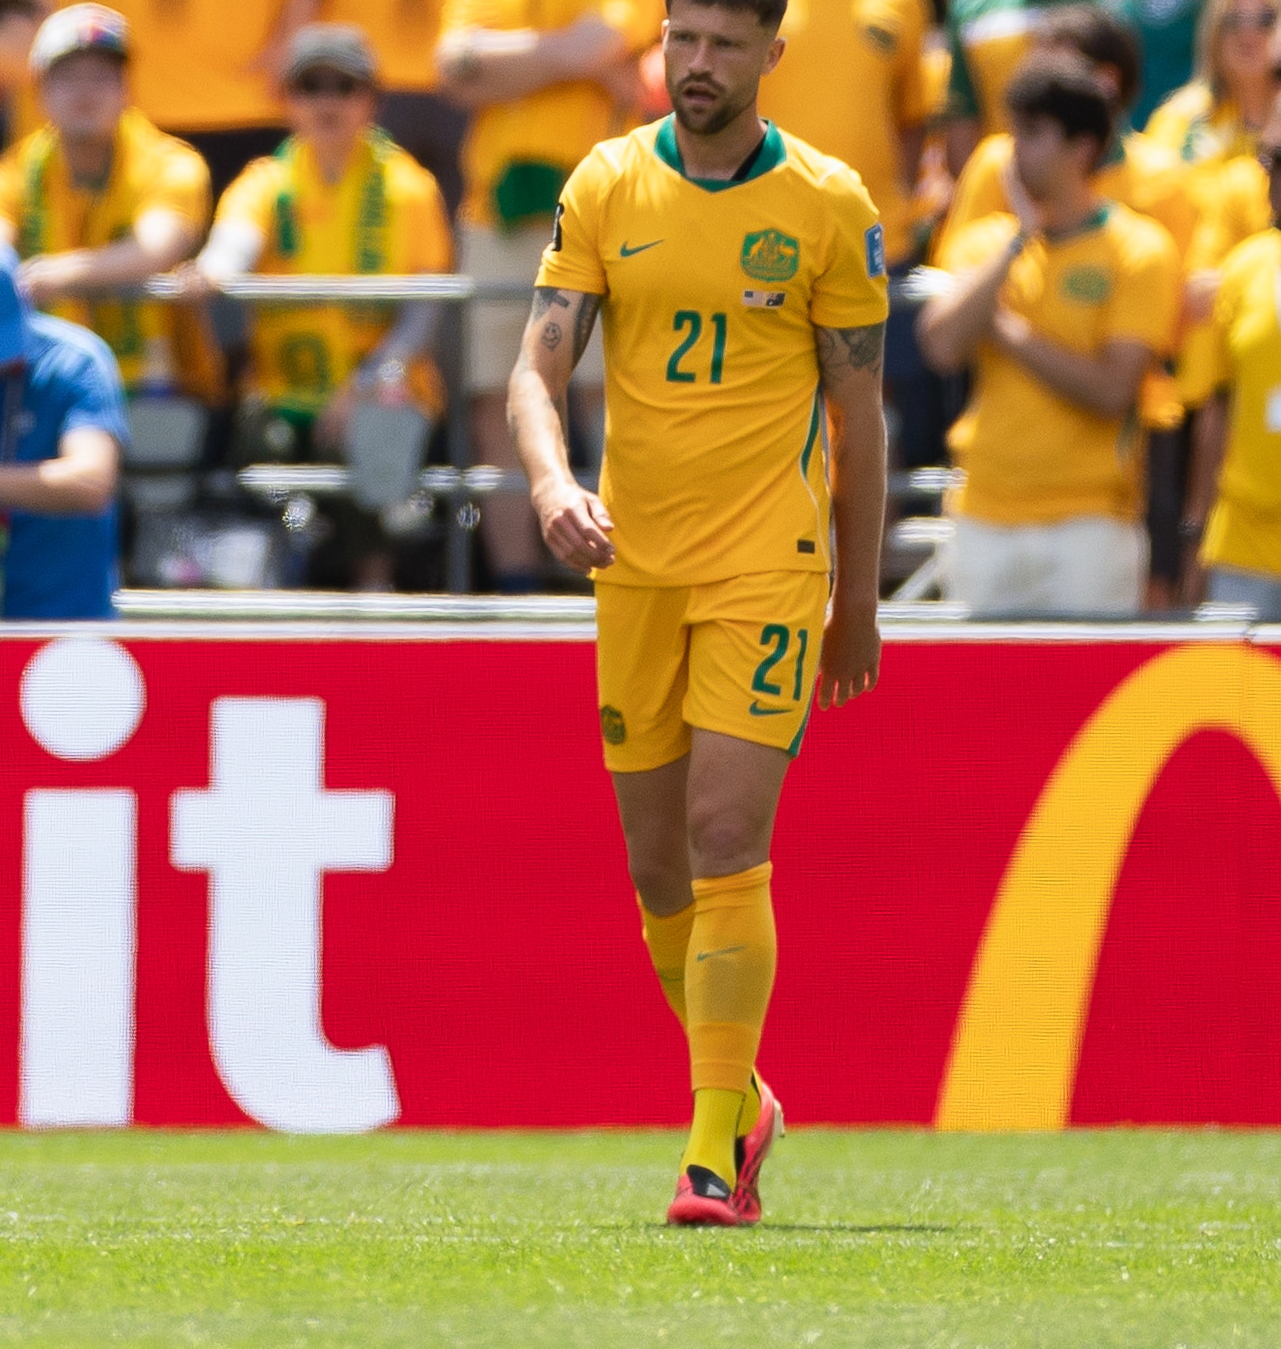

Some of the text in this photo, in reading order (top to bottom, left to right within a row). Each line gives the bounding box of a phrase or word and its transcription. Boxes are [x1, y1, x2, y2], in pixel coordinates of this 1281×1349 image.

[665, 309, 727, 384] 21
[751, 623, 809, 701] 21
[18, 635, 401, 1135] it
